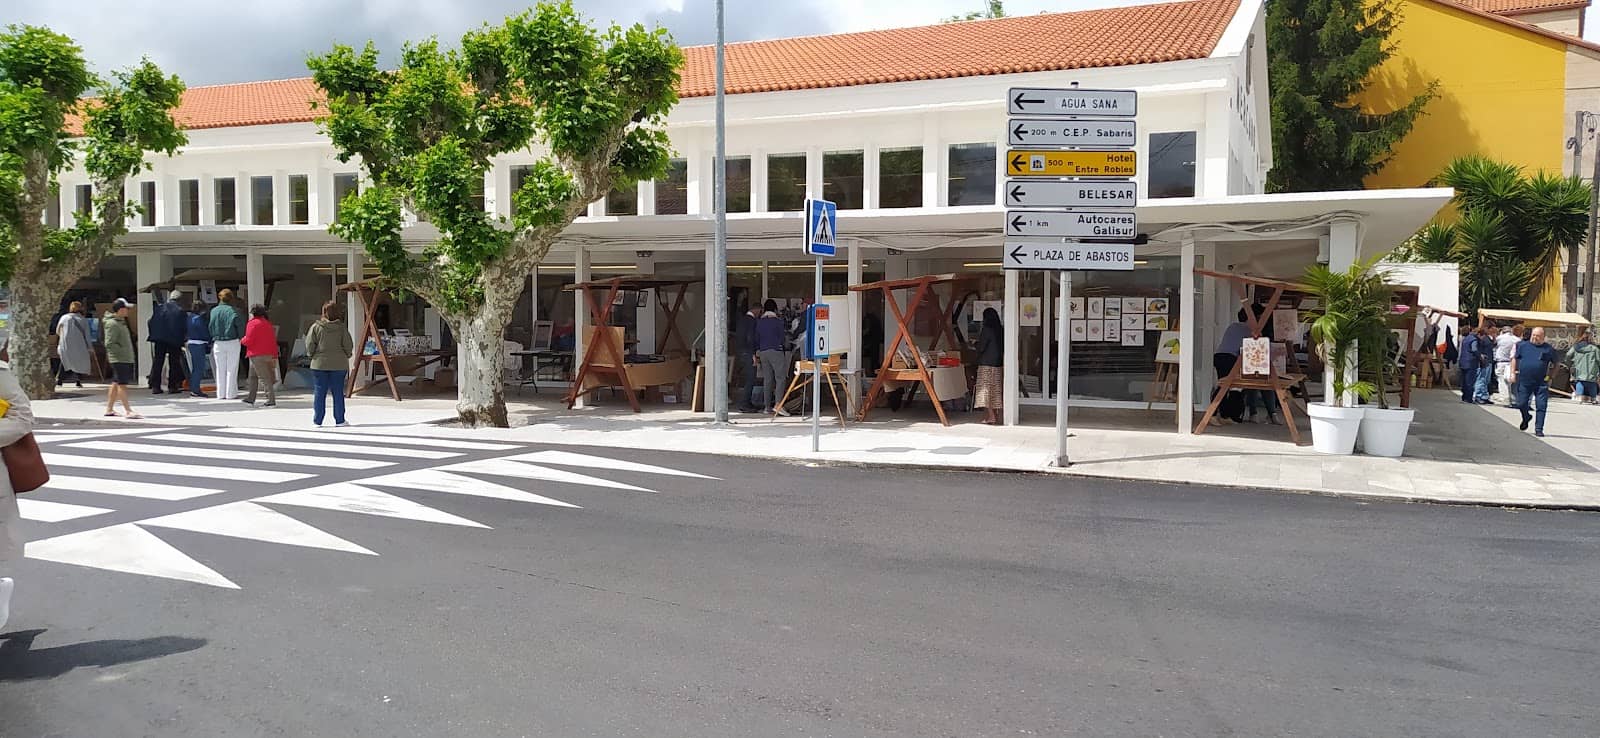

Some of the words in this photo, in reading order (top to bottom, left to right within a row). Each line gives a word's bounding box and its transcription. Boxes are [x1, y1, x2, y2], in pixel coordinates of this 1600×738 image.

[1061, 98, 1087, 109] AGUA
[1092, 99, 1118, 109] SANA
[1107, 154, 1133, 162] Hotel
[1104, 165, 1133, 173] Robles
[1079, 190, 1133, 199] BELESAR
[1078, 215, 1133, 224] Autocares
[1093, 226, 1133, 235] Galisur
[1033, 250, 1064, 261] PLAZA
[1068, 251, 1081, 261] DE
[1086, 251, 1129, 262] ABASTOS
[819, 337, 824, 350] 0
